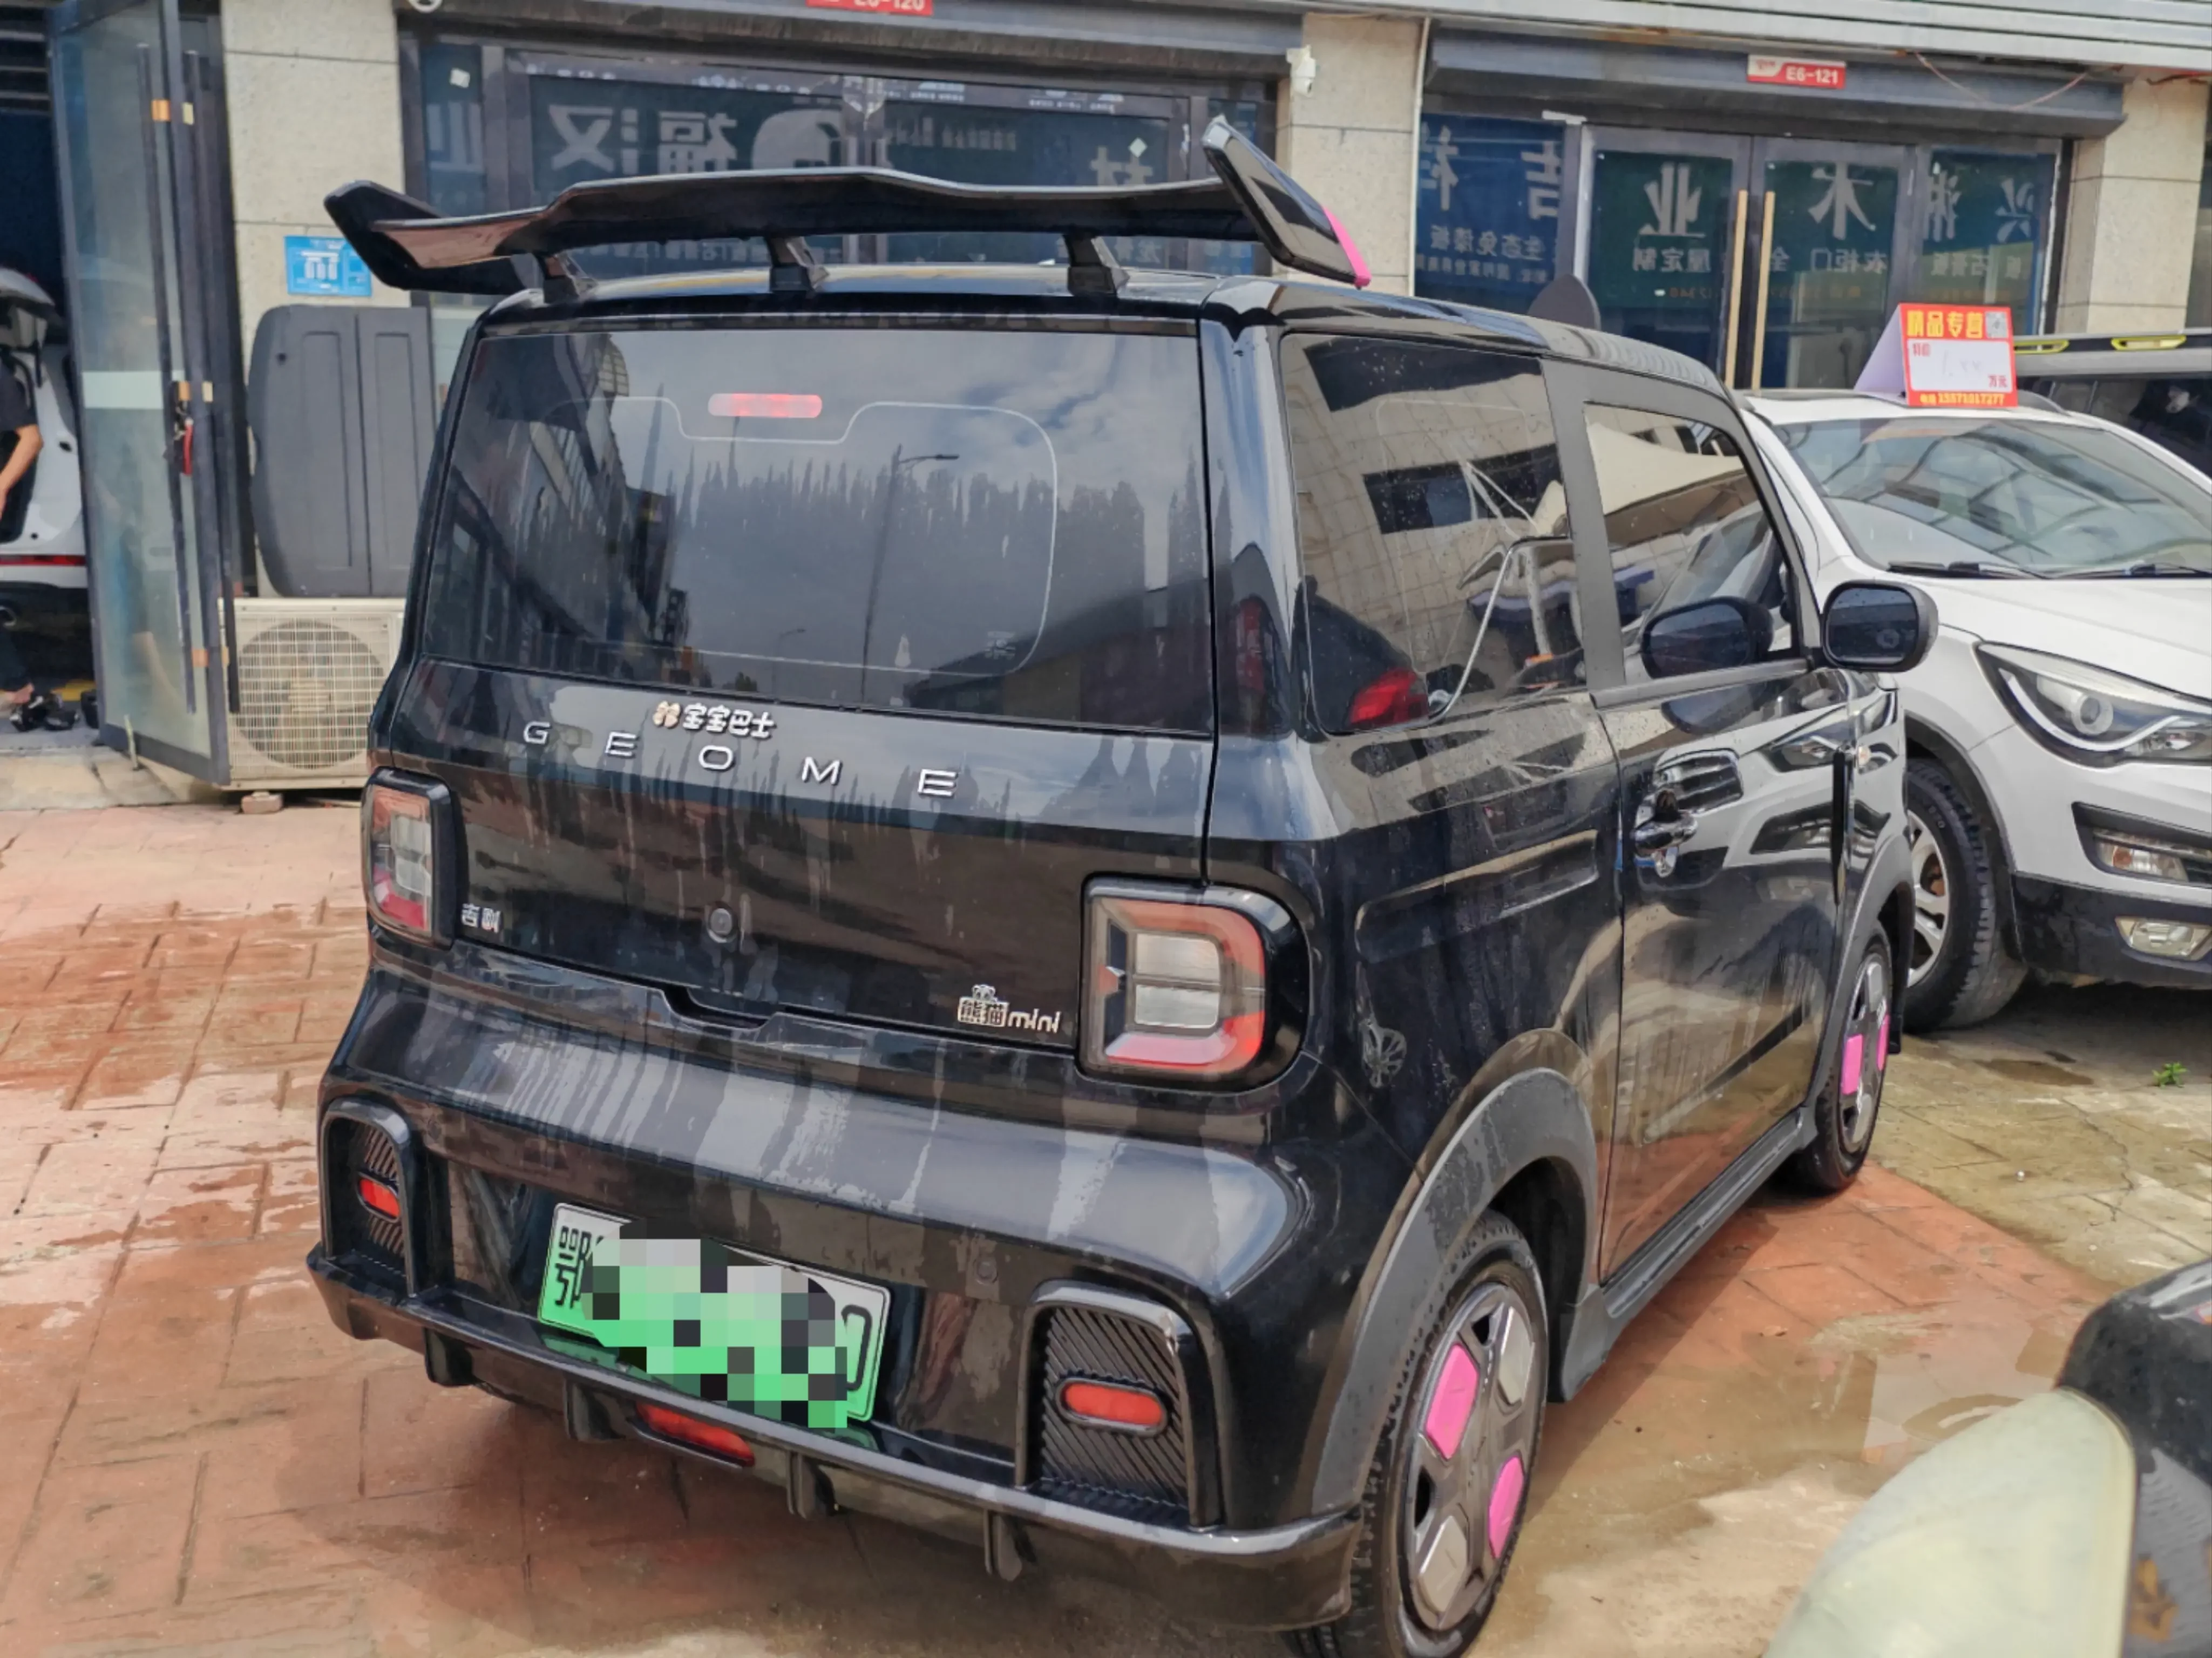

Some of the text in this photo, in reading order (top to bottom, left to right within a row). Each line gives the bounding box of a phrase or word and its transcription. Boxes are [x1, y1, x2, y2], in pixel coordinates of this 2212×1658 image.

[1786, 65, 1838, 85] E6-121
[1988, 374, 2008, 388] 万元
[682, 702, 775, 739] 宝宝巴士
[522, 720, 960, 798] GEOME
